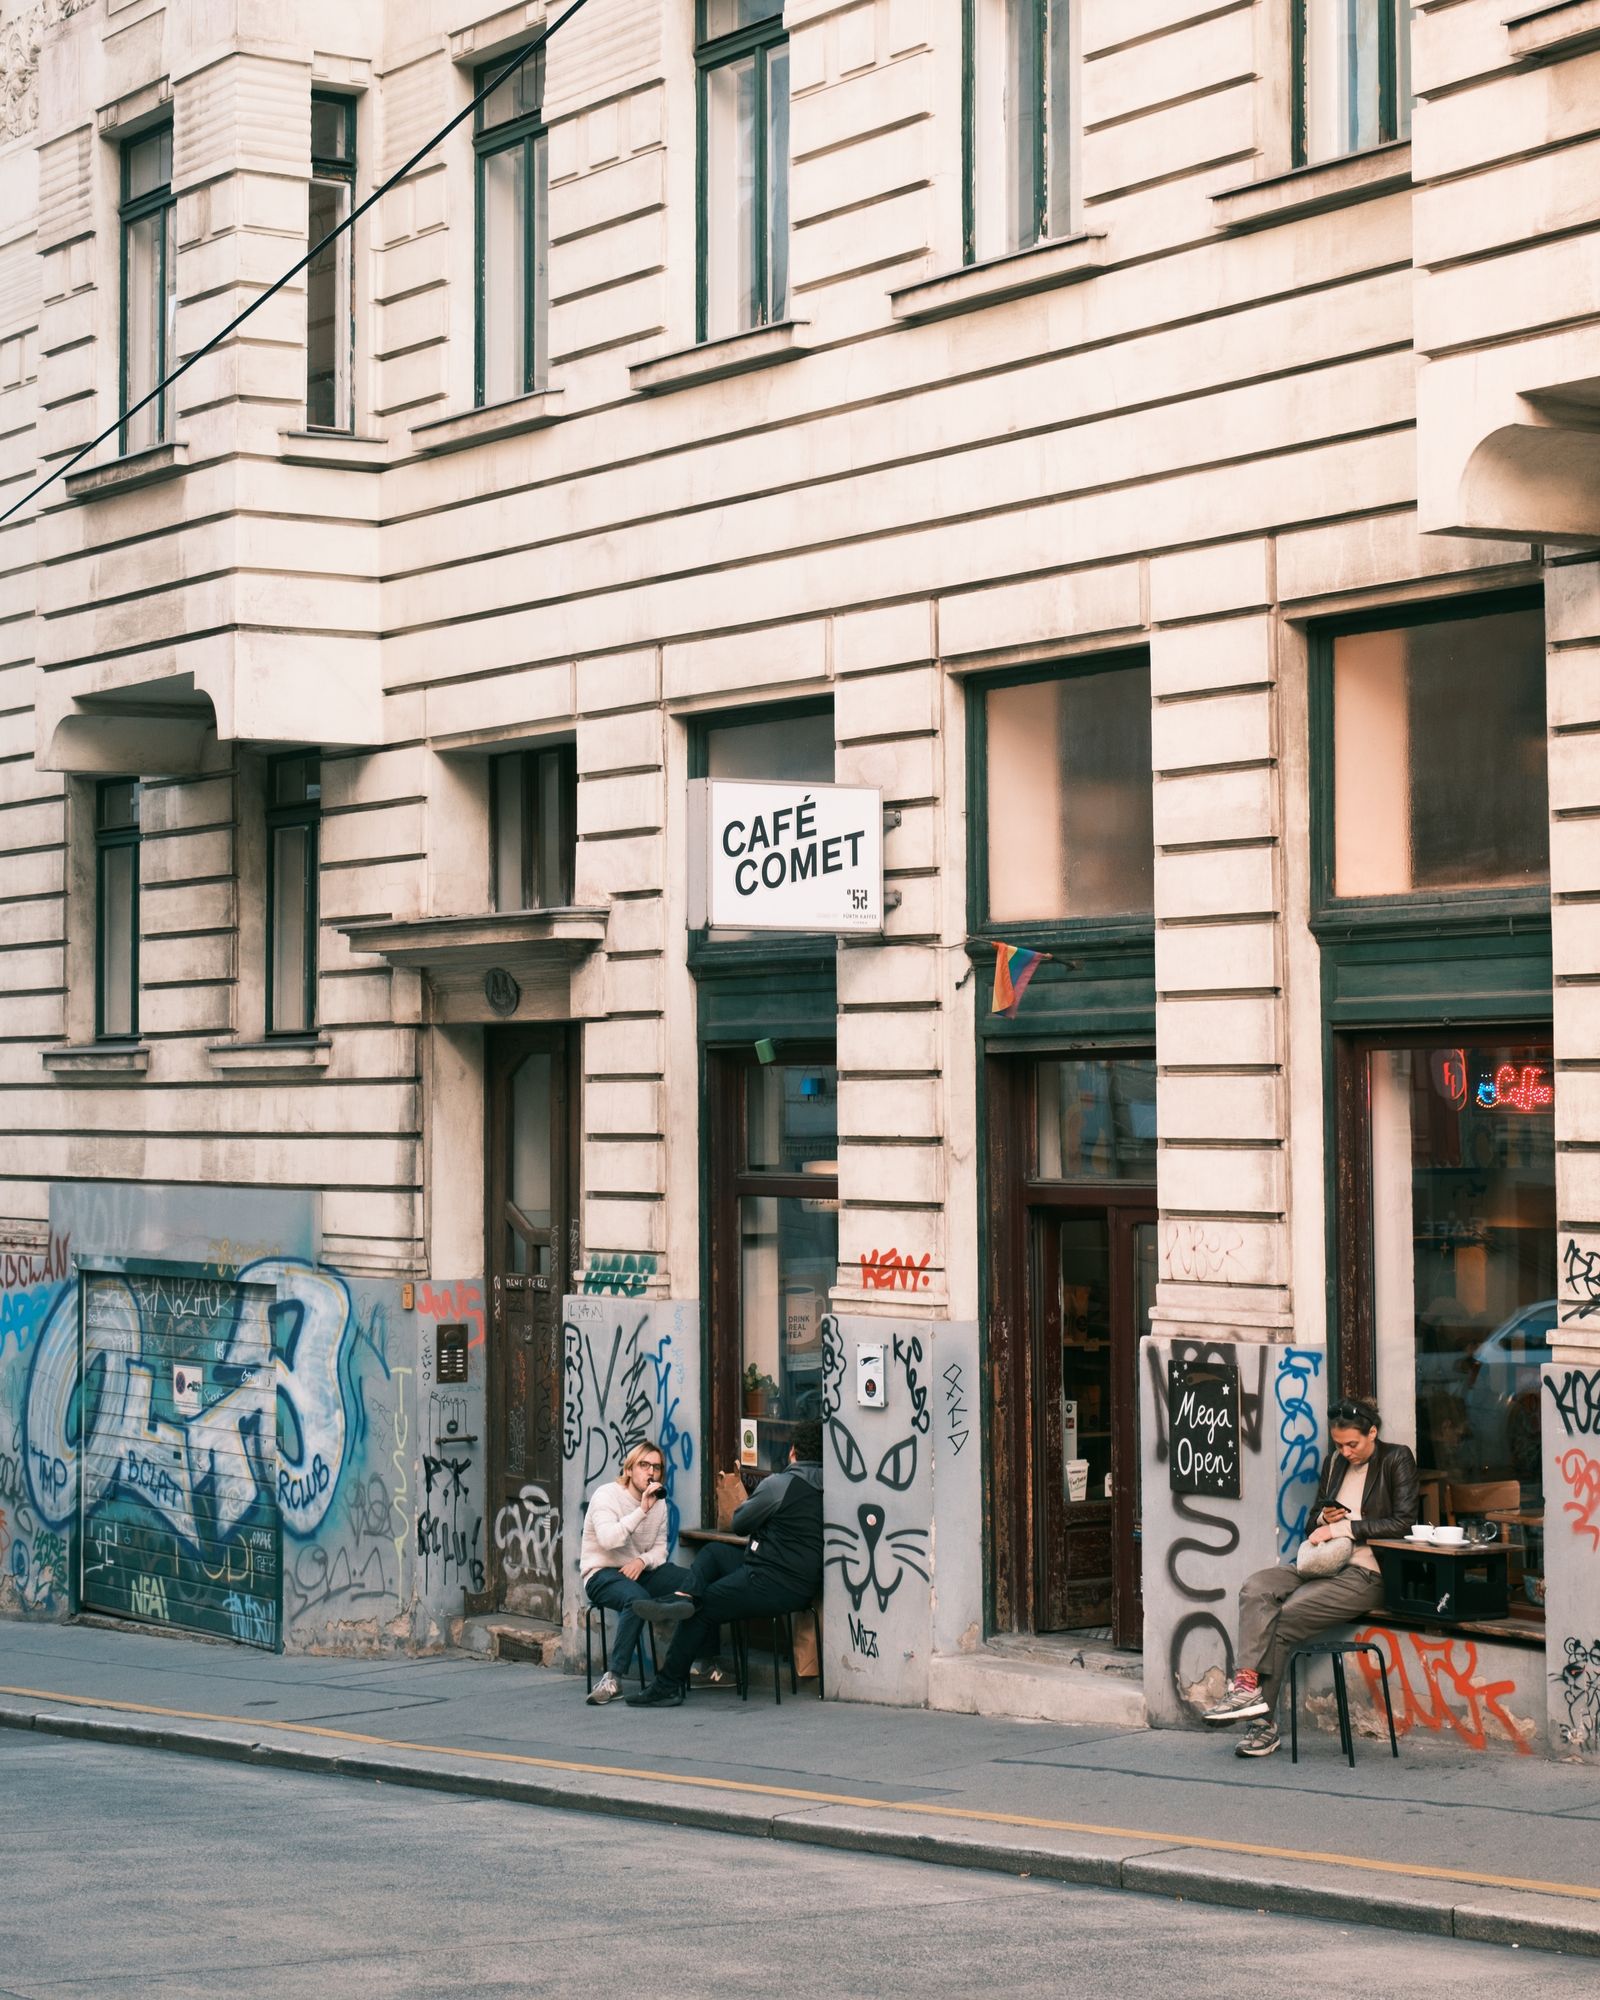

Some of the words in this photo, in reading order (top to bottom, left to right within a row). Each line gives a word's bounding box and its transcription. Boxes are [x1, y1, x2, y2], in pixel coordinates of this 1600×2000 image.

[722, 794, 817, 858] CAFÉ
[735, 830, 866, 896] COMET
[788, 1315, 810, 1323] DRINK
[788, 1323, 807, 1331] REAL
[788, 1331, 803, 1339] TEA
[1174, 1391, 1233, 1444] Mega
[1177, 1437, 1234, 1485] Open
